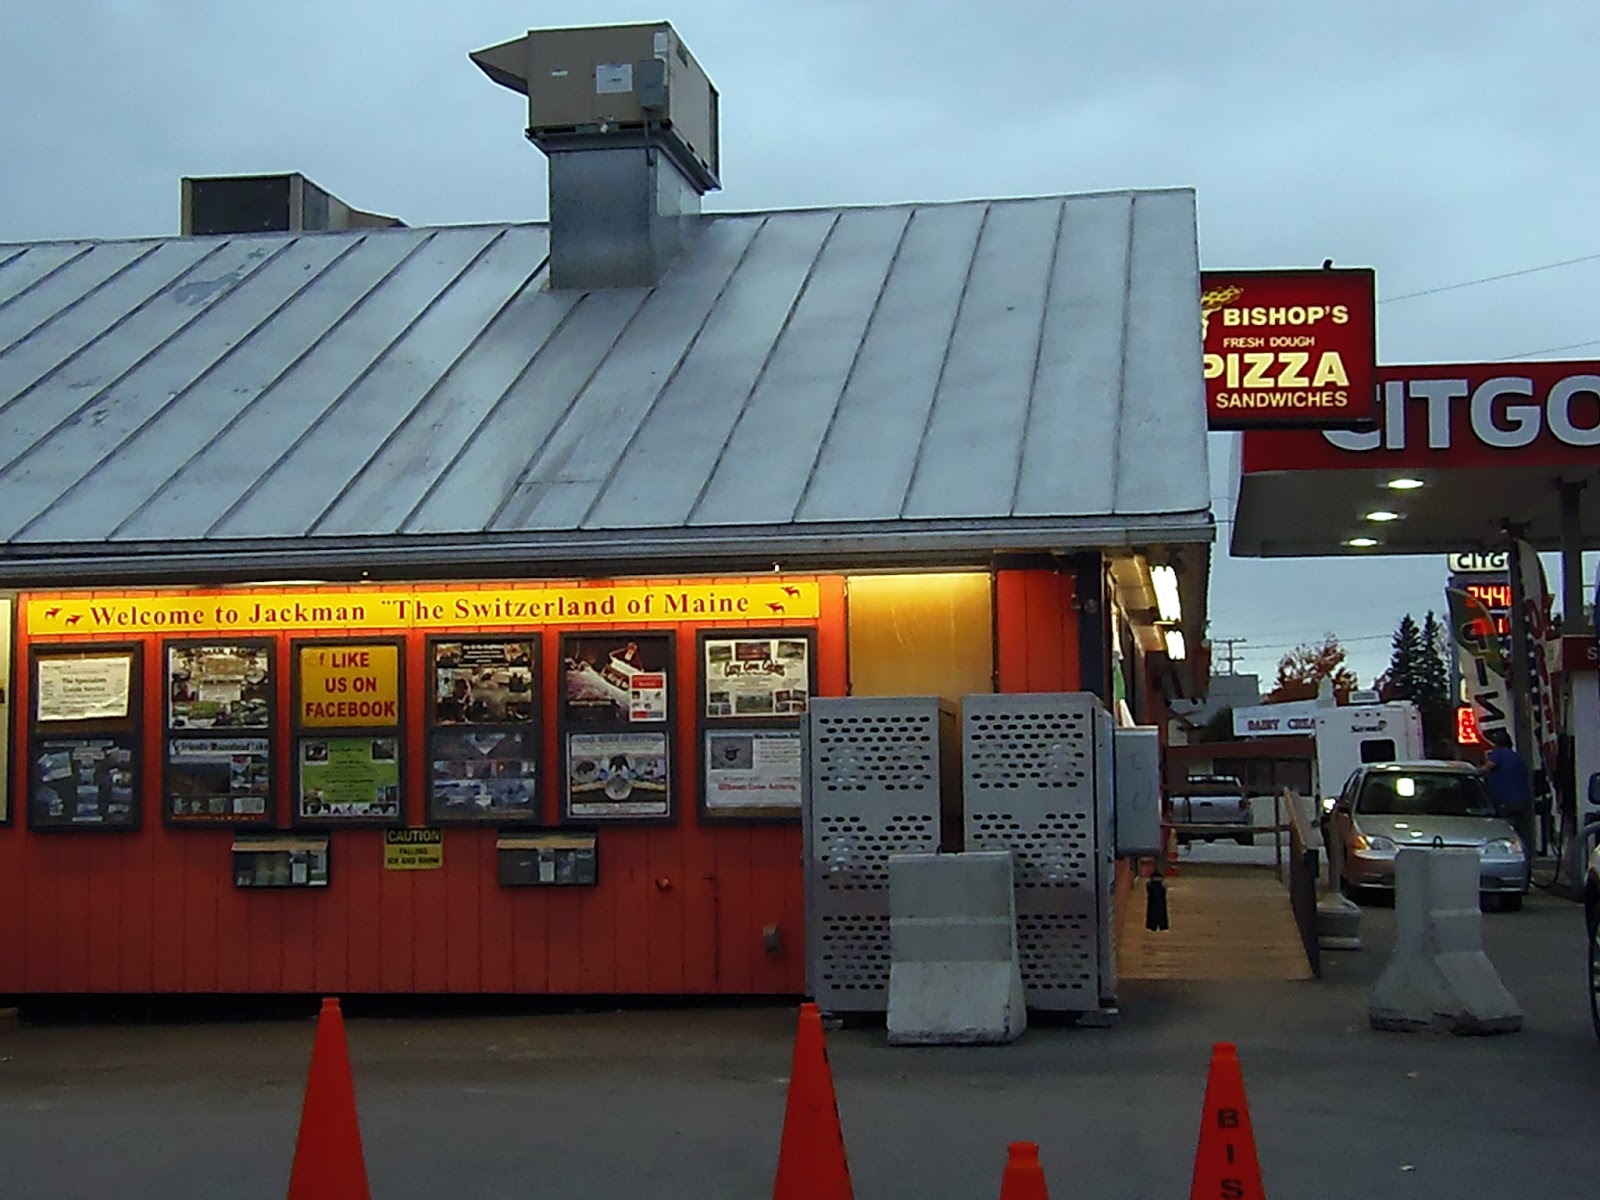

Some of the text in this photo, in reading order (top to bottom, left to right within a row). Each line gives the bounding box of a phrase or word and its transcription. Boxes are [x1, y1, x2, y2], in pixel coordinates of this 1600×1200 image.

[1223, 305, 1349, 326] BISHOP'S
[1223, 336, 1315, 348] FRESH DOUGH
[1216, 391, 1348, 408] SANDWICHES
[90, 604, 204, 627] Welcome
[215, 605, 239, 625] to
[248, 602, 366, 624] Jackman
[455, 595, 616, 620] Switzerland
[627, 593, 655, 615] of
[663, 593, 750, 614] Maine
[332, 652, 369, 668] LIKE
[325, 676, 377, 693] US ON
[305, 701, 396, 718] FACEBOOK
[388, 829, 440, 842] CAUTION
